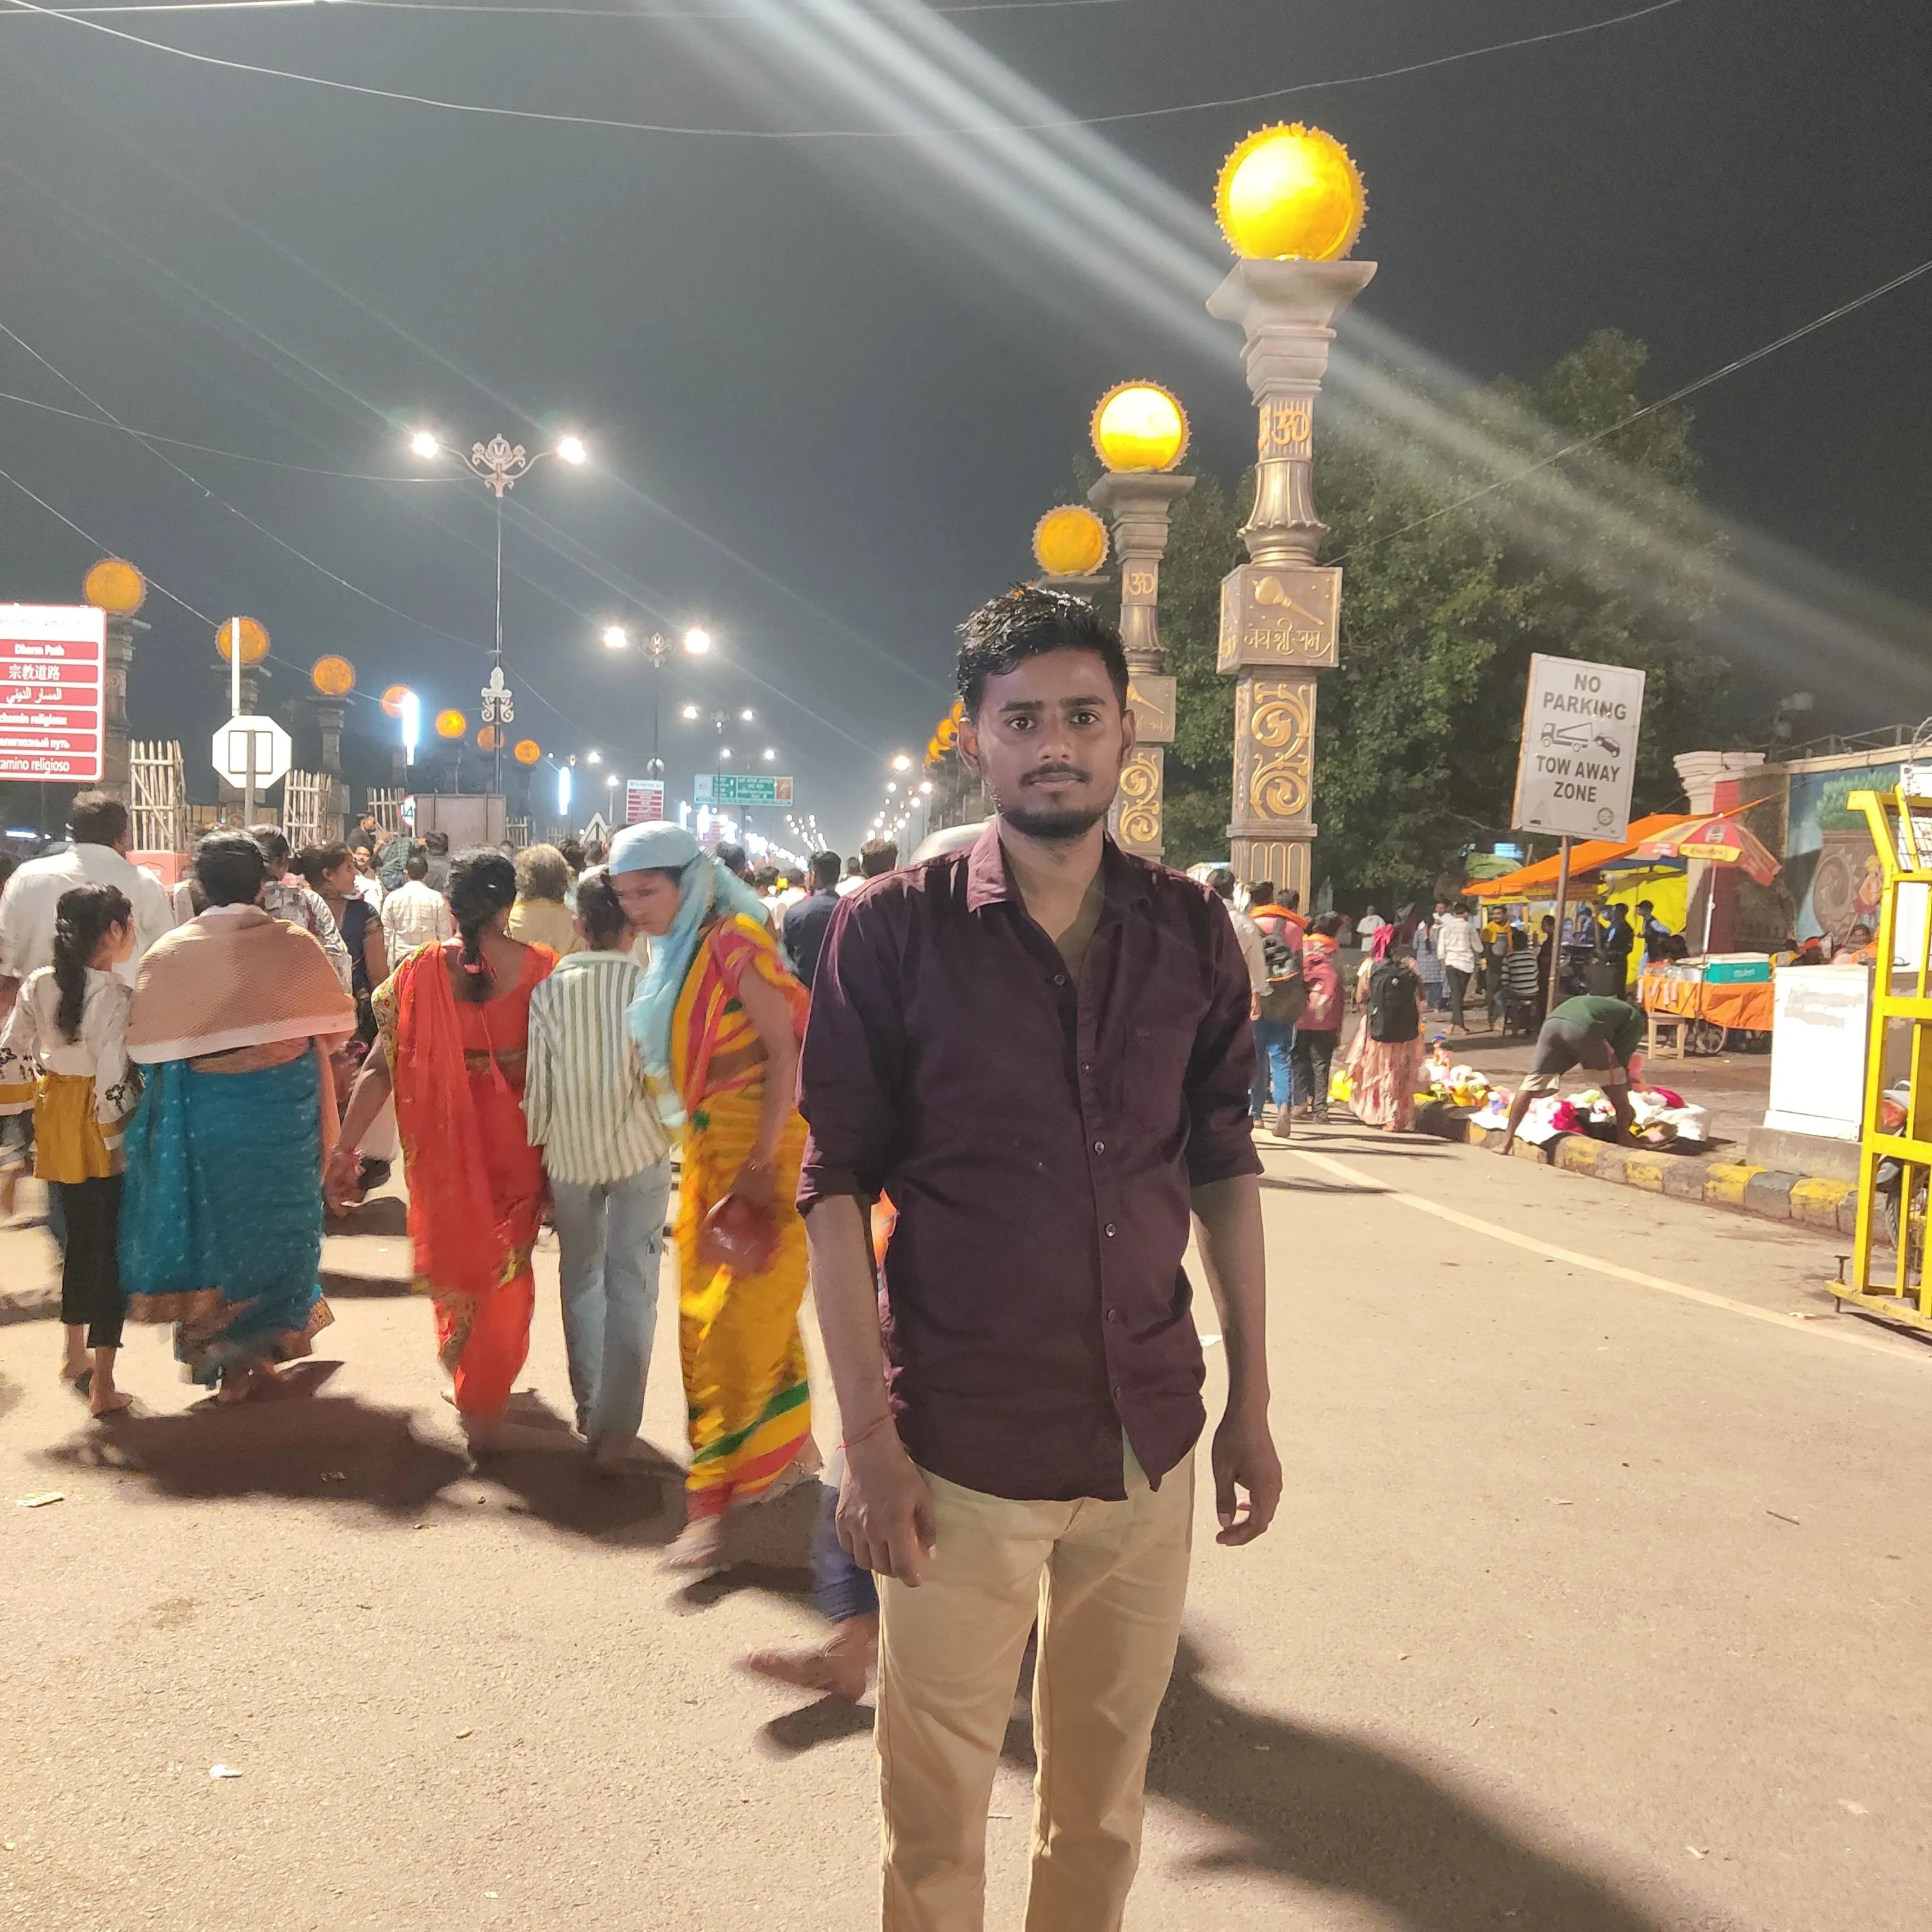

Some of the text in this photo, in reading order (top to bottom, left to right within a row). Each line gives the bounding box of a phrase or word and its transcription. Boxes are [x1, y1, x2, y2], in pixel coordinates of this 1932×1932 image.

[1244, 628, 1273, 649] जय
[8, 663, 61, 681] 宗教道路
[1574, 673, 1602, 693] NO
[34, 687, 62, 704] المسار
[1542, 691, 1627, 721] PARKING
[30, 757, 71, 775] religioso
[1536, 755, 1622, 782] TOW AWAY
[1553, 781, 1598, 803] ZONE
